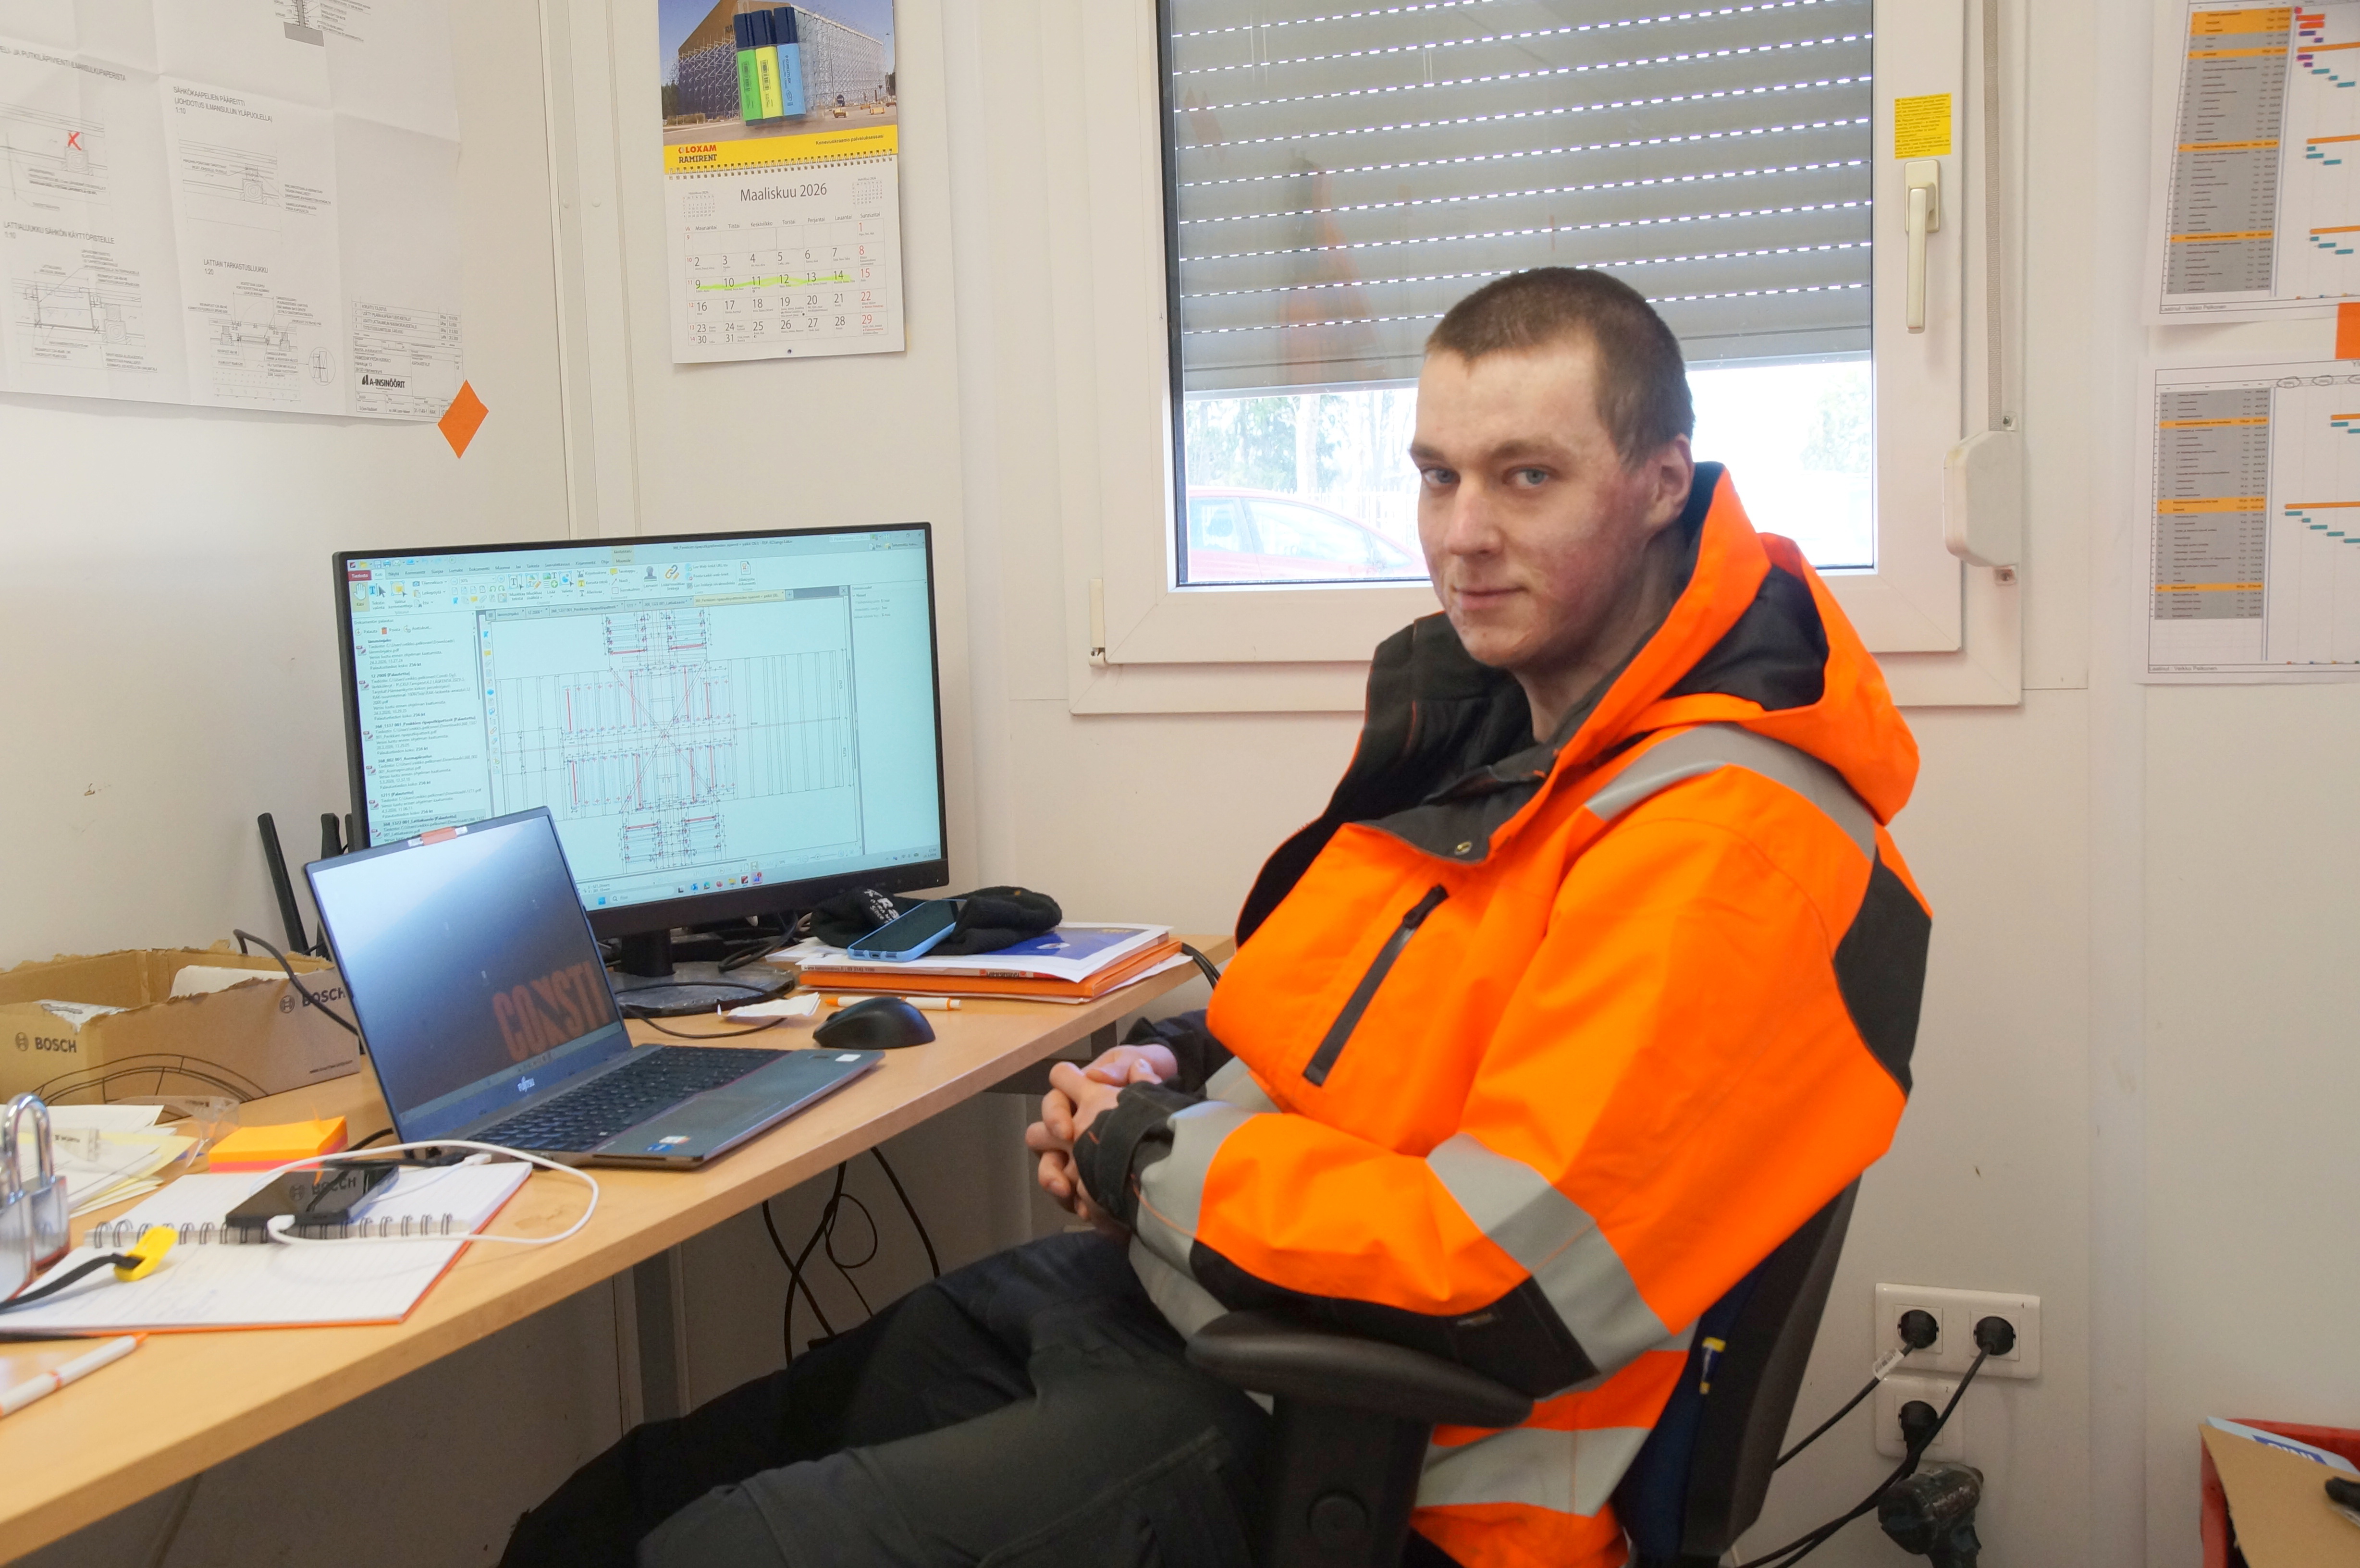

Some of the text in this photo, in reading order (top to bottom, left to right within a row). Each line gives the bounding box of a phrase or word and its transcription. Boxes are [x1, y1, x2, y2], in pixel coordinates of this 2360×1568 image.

[173, 86, 245, 106] SÄHKÖKAAPELIEN PÄÄREITTI
[174, 98, 205, 109] (JOHDOTUS
[685, 145, 717, 154] LOXAM
[679, 154, 717, 163] RAMIRENT
[740, 183, 827, 202] Maaliskuu 2026
[859, 222, 862, 232] 1
[695, 257, 700, 266] 2
[723, 255, 727, 265] 3
[750, 254, 755, 263] 4
[778, 252, 783, 261] 5
[805, 250, 810, 259] 6
[832, 247, 837, 257] 7
[860, 245, 864, 255] 8
[204, 258, 268, 273] LATTIAN TARKASTUSLUUKKU
[696, 280, 701, 288] 9
[724, 278, 734, 287] 10
[752, 276, 761, 285] 11
[779, 274, 789, 283] 12
[807, 272, 816, 282] 13
[834, 270, 844, 280] 14
[861, 269, 870, 278] 15
[697, 302, 707, 311] 16
[725, 301, 735, 310] 17
[753, 299, 762, 308] 18
[780, 297, 790, 306] 19
[807, 295, 817, 305] 20
[835, 294, 843, 303] 21
[861, 292, 871, 301] 22
[753, 321, 763, 331] 25
[781, 320, 791, 329] 26
[808, 318, 818, 327] 27
[835, 316, 845, 326] 28
[862, 314, 872, 324] 29
[369, 378, 406, 389] A-INSINÖÖRIT
[35, 1037, 77, 1054] BOSCH
